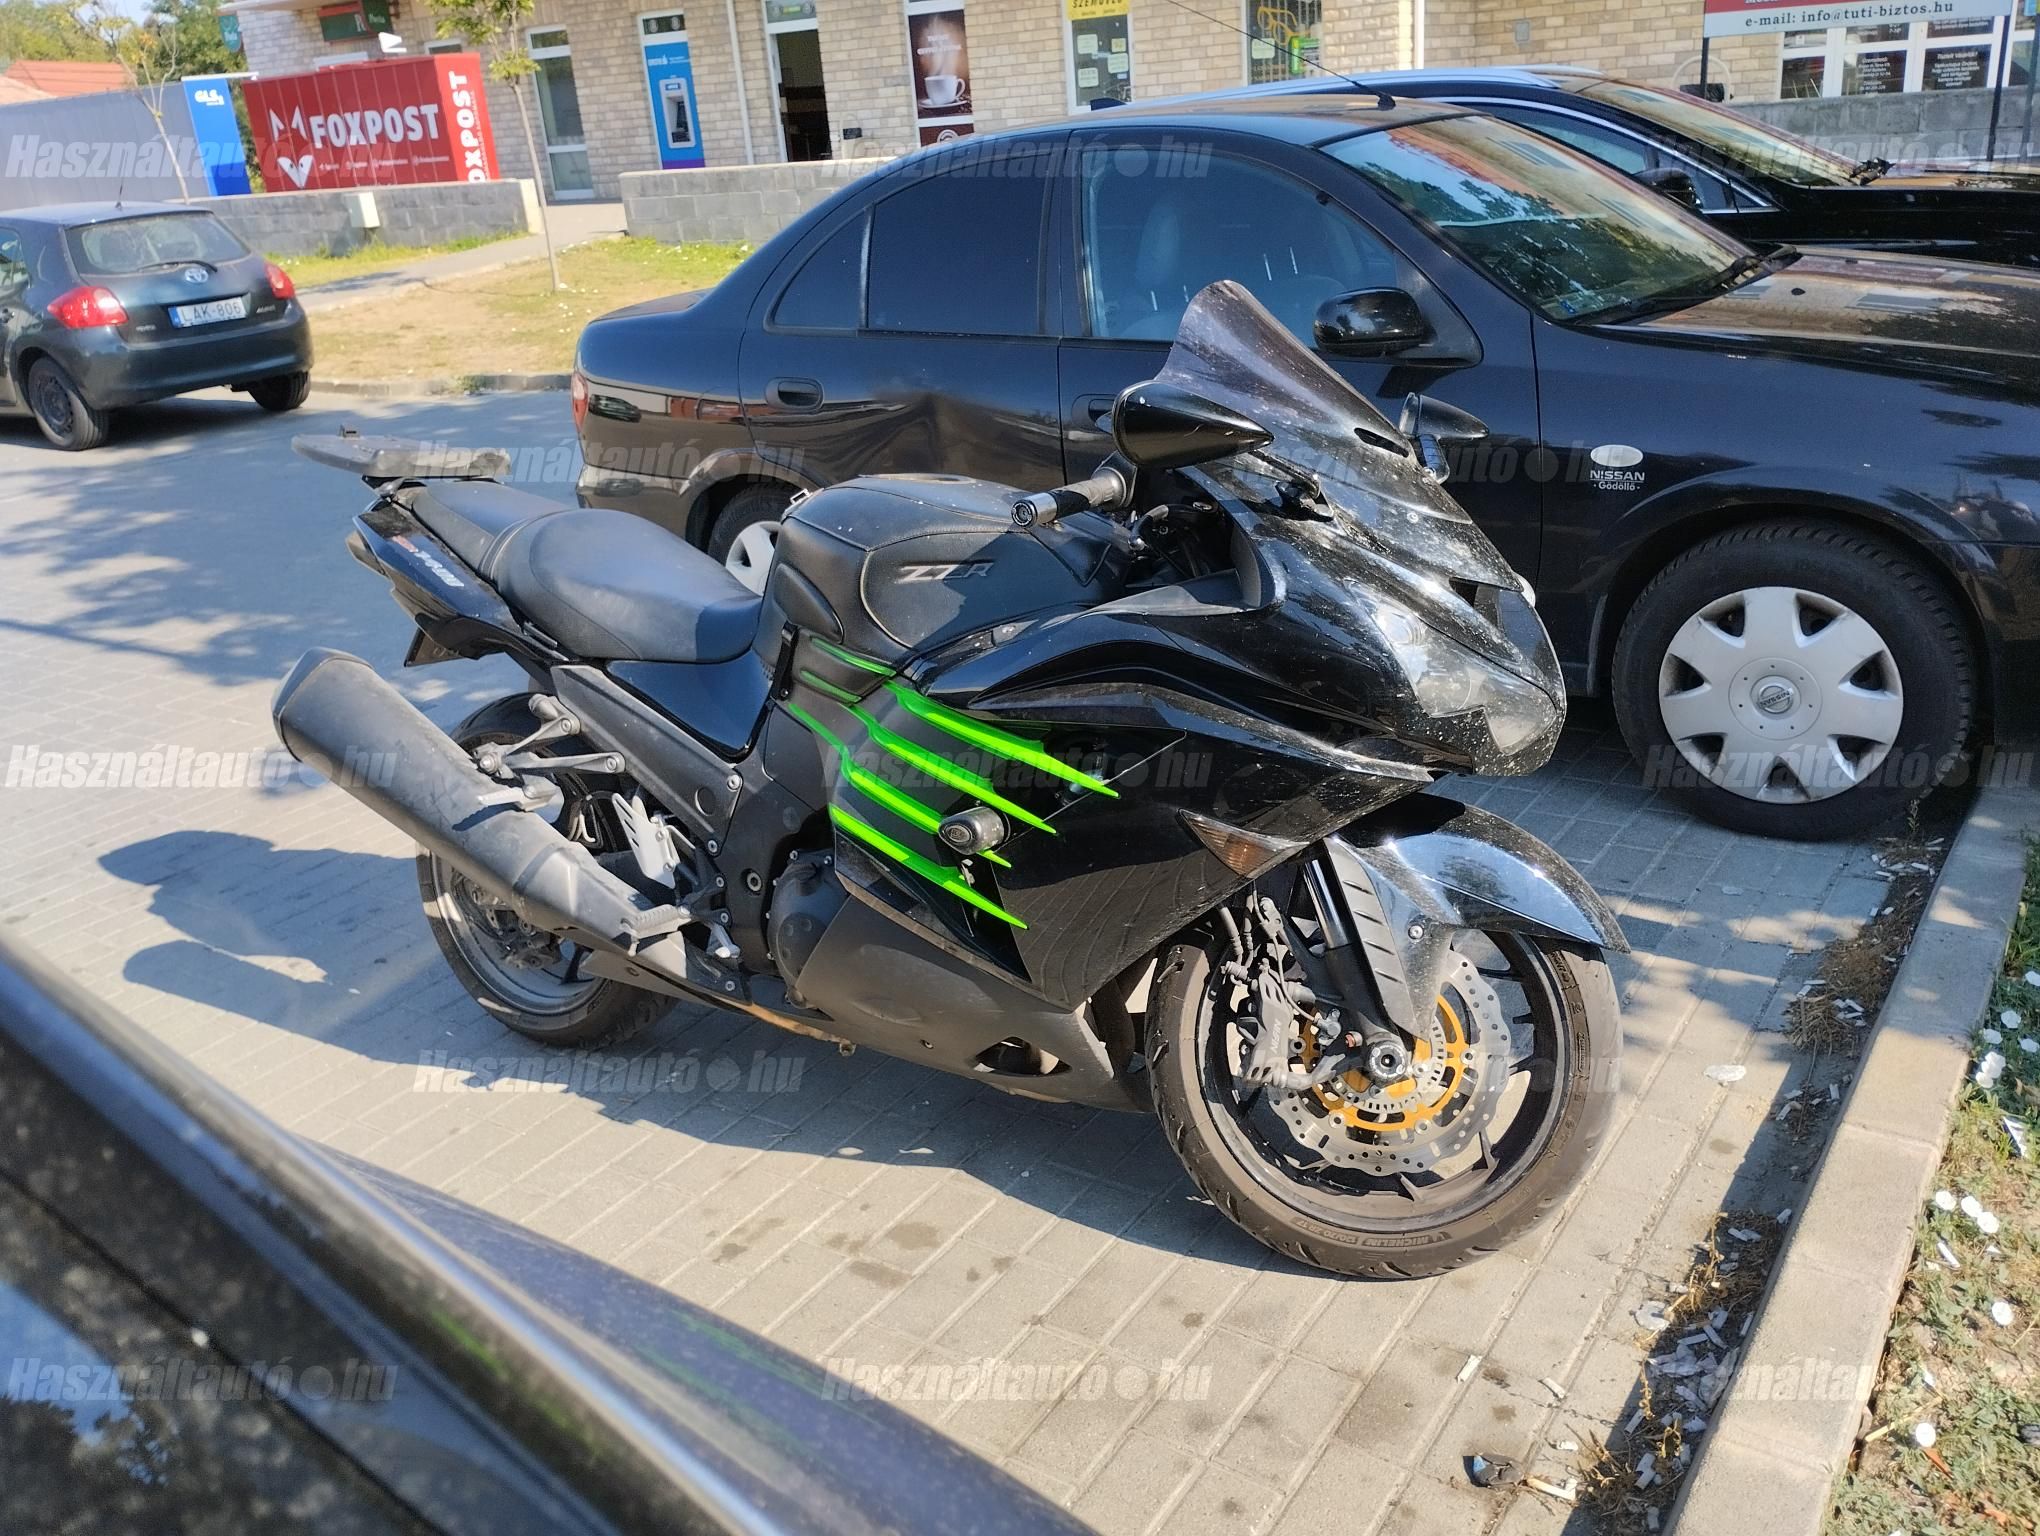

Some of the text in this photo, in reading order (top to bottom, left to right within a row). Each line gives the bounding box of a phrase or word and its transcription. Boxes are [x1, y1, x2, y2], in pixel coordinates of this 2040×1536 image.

[1745, 1, 1953, 27] e-mail: info@tuti-biztos.hu
[309, 103, 439, 149] FOXPOST
[448, 70, 487, 184] OXPOST
[181, 302, 242, 323] LAK-806
[1590, 470, 1645, 481] NISSAN
[1366, 1234, 1429, 1247] MICHELIN
